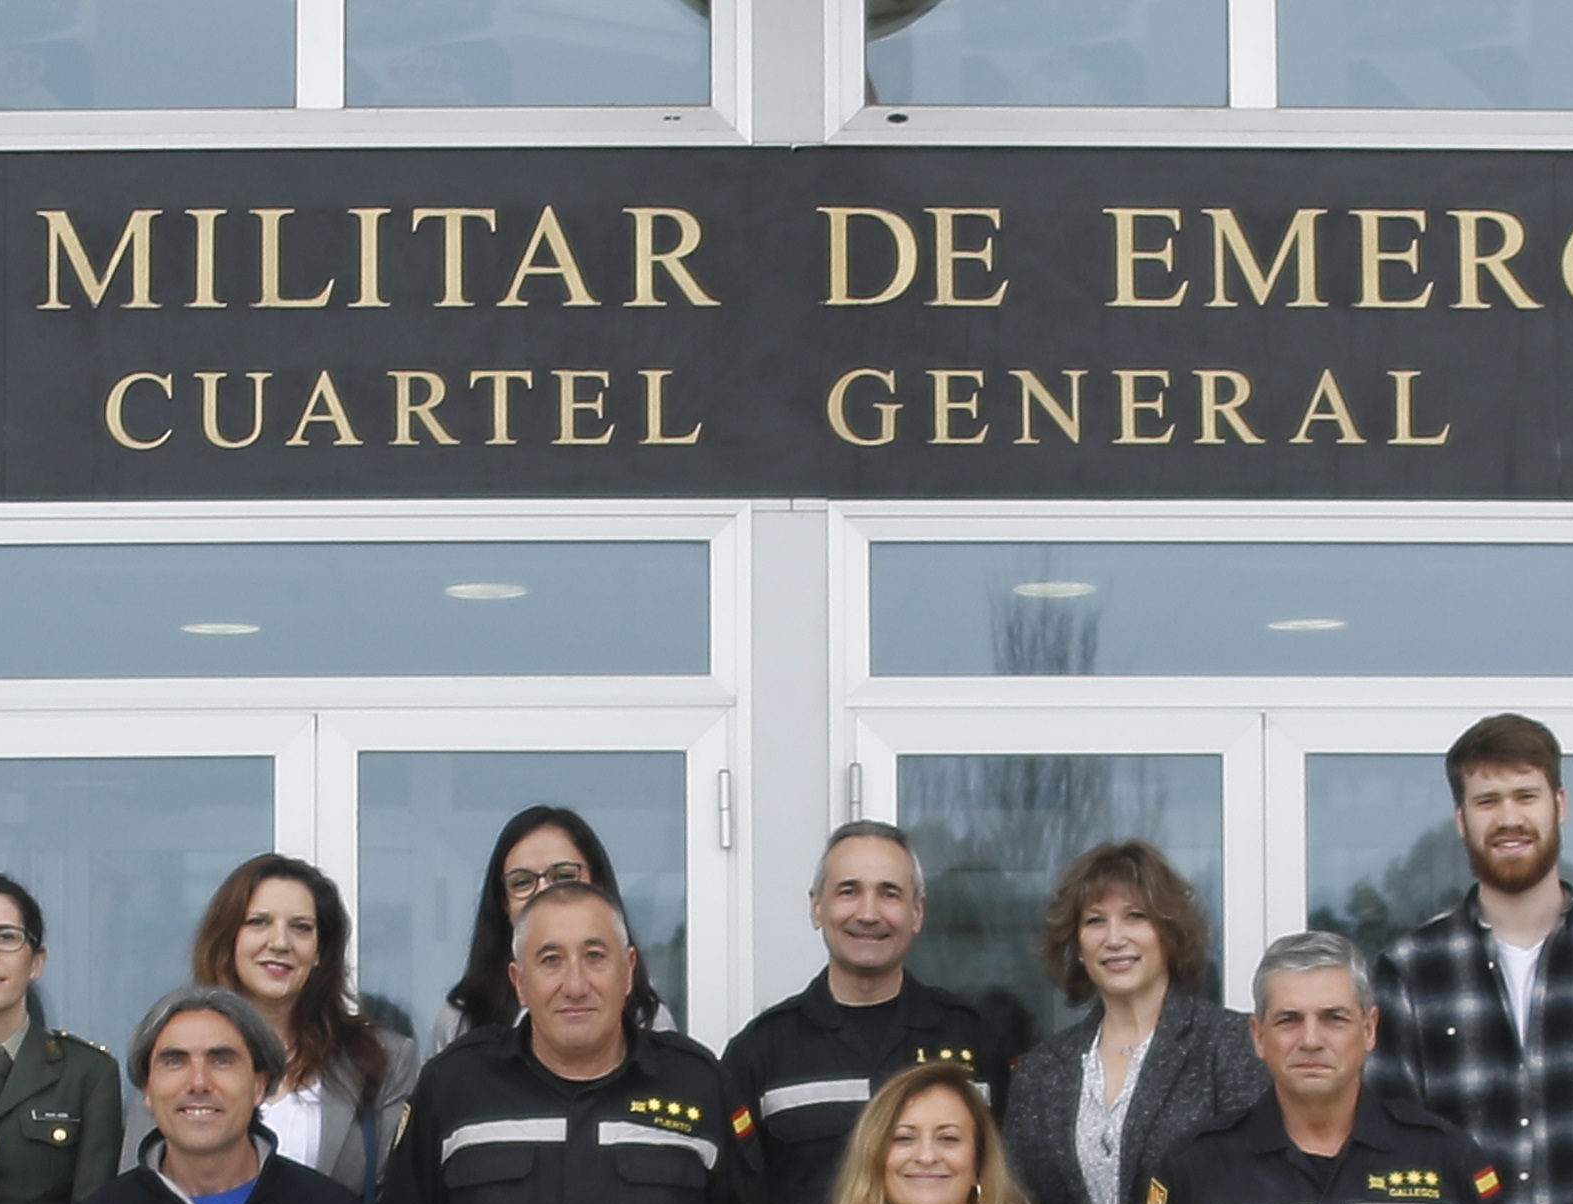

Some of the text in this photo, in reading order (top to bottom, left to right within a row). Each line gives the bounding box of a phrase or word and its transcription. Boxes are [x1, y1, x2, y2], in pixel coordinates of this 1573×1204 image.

[37, 206, 719, 309] MILITAR
[817, 206, 1008, 307] DE
[104, 368, 1450, 449] CUARTEL GENERAL
